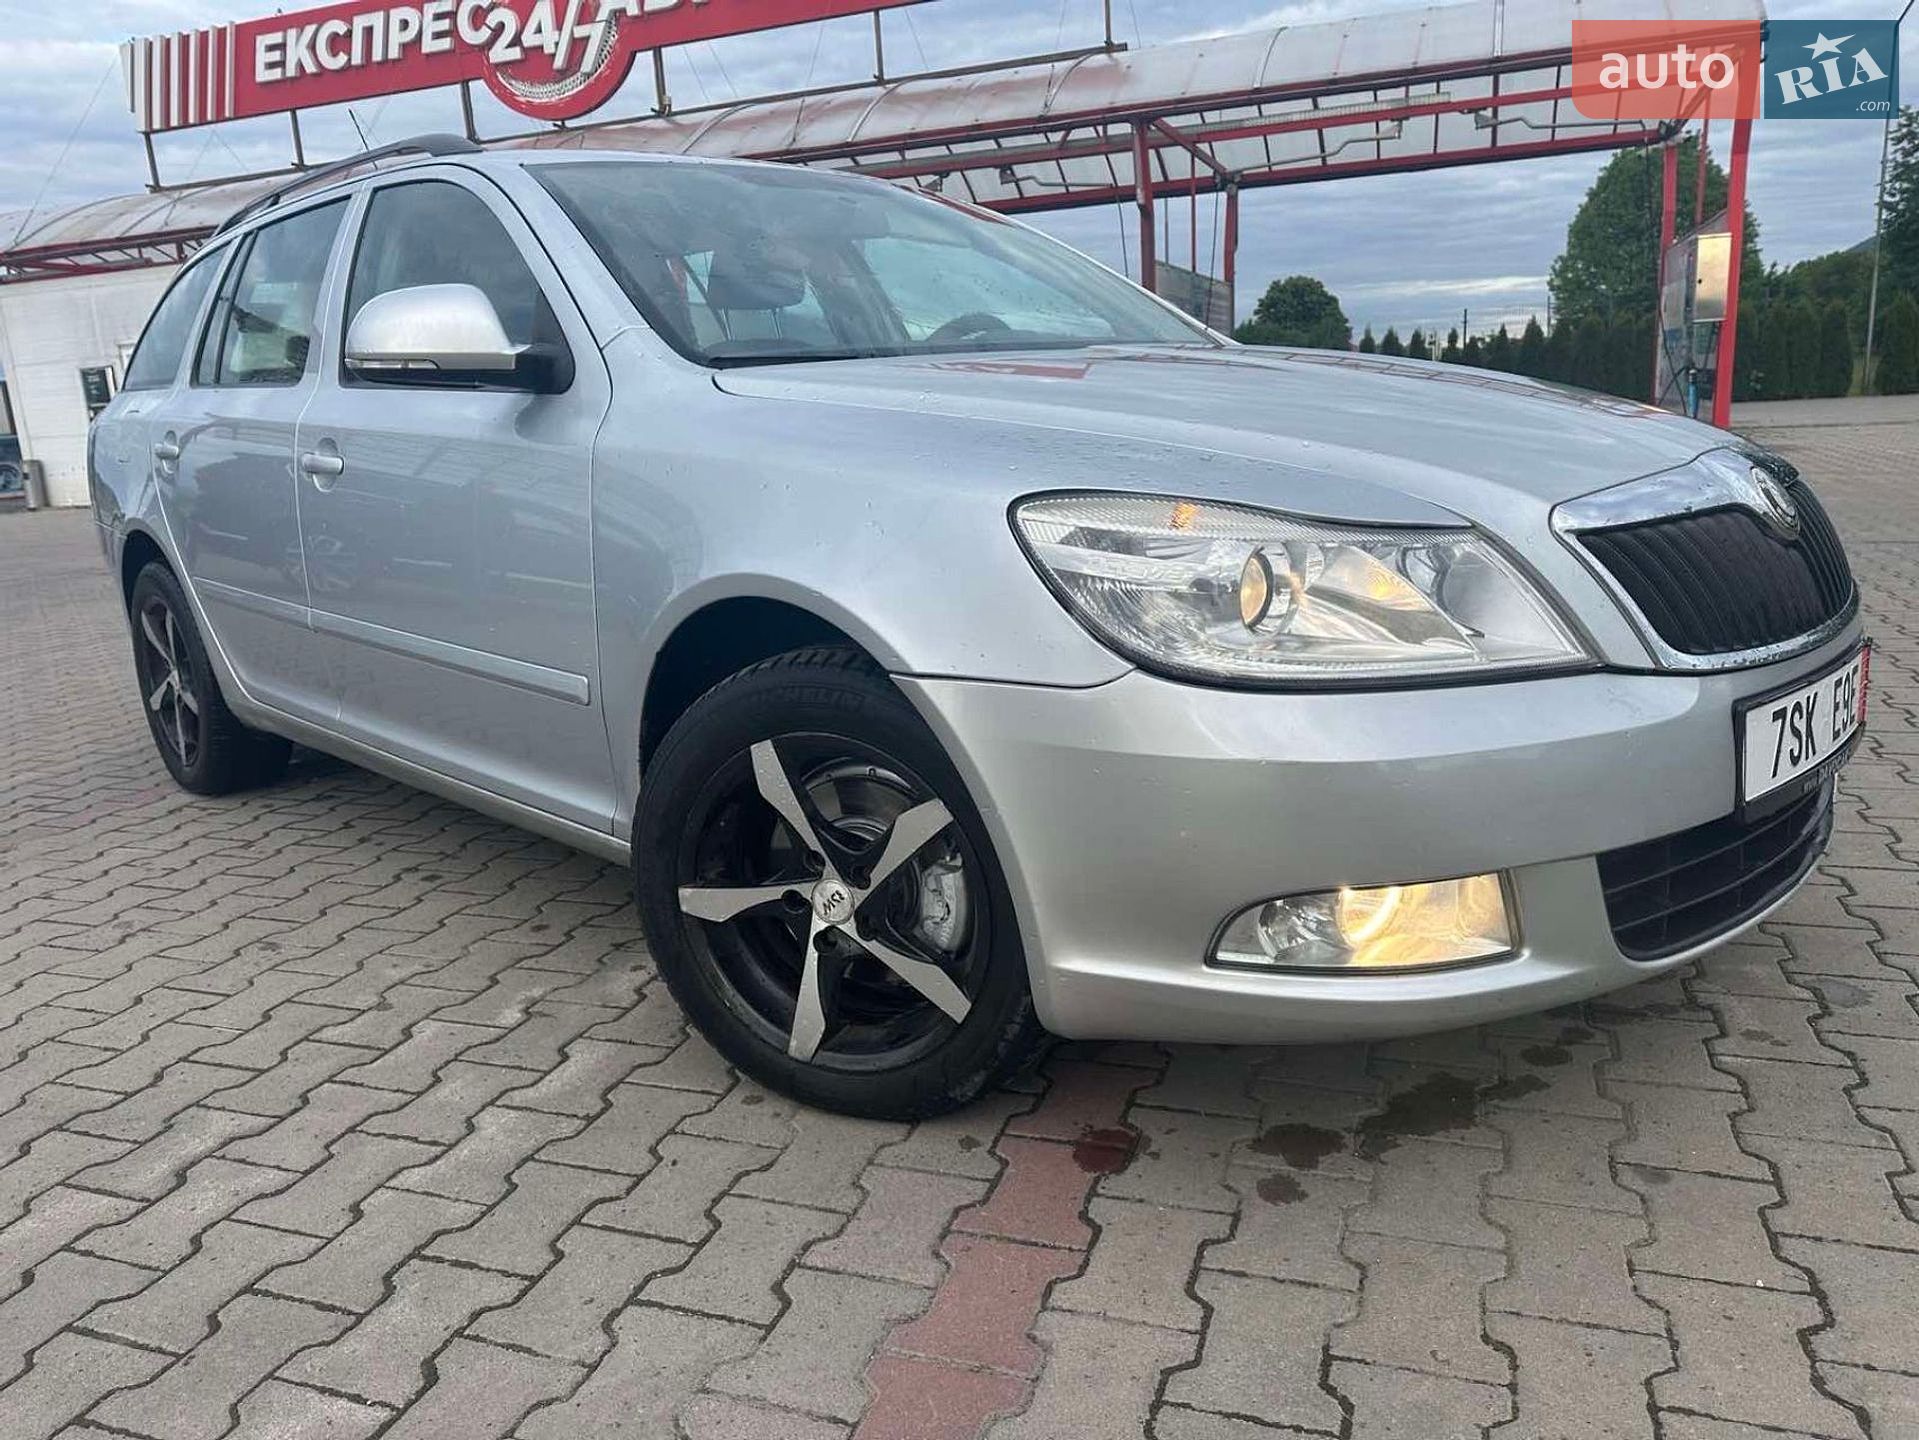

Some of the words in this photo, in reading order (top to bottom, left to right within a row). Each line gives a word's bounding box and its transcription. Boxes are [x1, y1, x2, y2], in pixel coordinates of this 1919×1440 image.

[255, 0, 494, 84] ЕКСПРЕС
[488, 0, 606, 75] 24/7
[1771, 691, 1818, 779] 7SK
